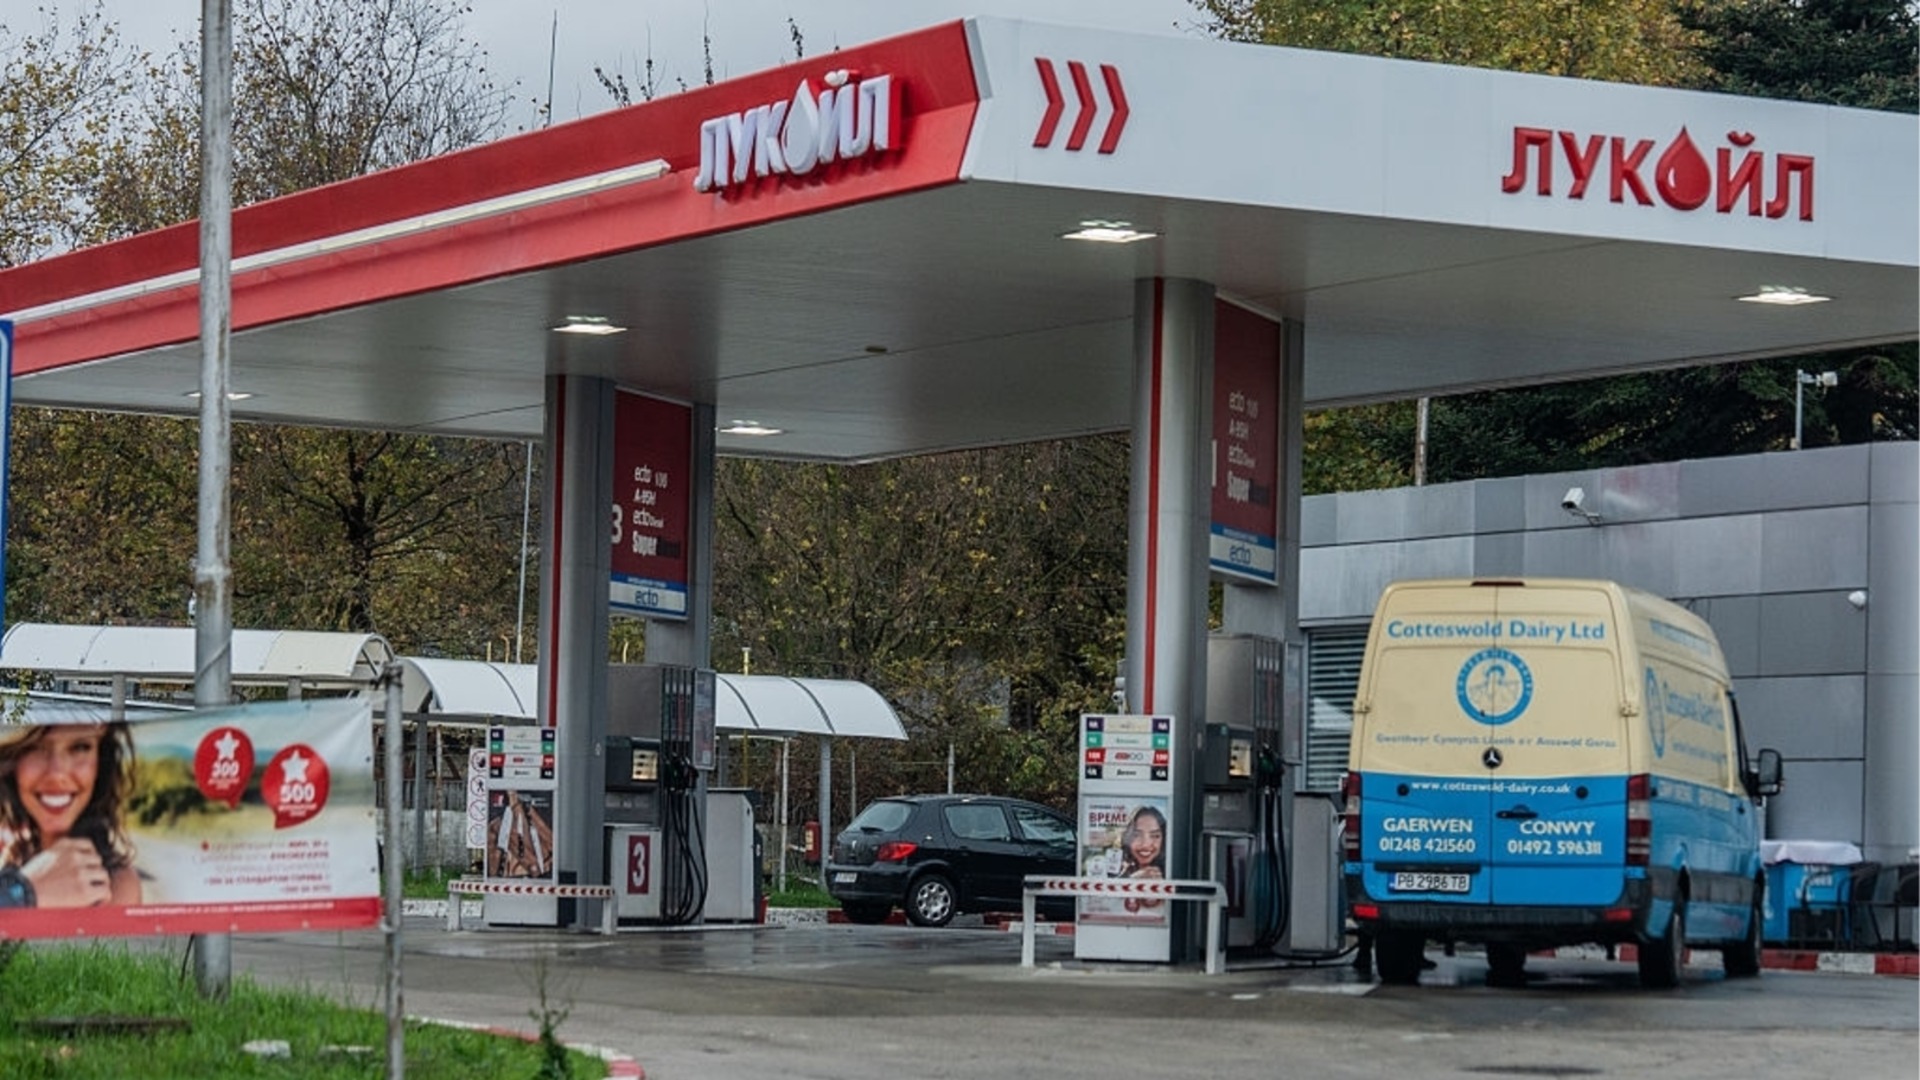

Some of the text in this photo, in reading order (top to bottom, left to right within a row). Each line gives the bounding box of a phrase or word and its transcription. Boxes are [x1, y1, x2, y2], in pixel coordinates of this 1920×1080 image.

[612, 504, 623, 544] 3
[635, 588, 659, 606] ecto
[1388, 620, 1604, 645] Cotteswold Dairy Ltd
[279, 782, 315, 803] 500
[1412, 781, 1571, 795] www.cotteswold-dairy.co.uk
[1382, 818, 1473, 833] GAERWEN
[1520, 821, 1595, 835] CONWY
[1379, 837, 1476, 854] 01248 421560
[1507, 839, 1602, 856] 01492 596311
[632, 842, 646, 888] 3
[1397, 874, 1414, 887] PB
[1417, 875, 1448, 889] 2986
